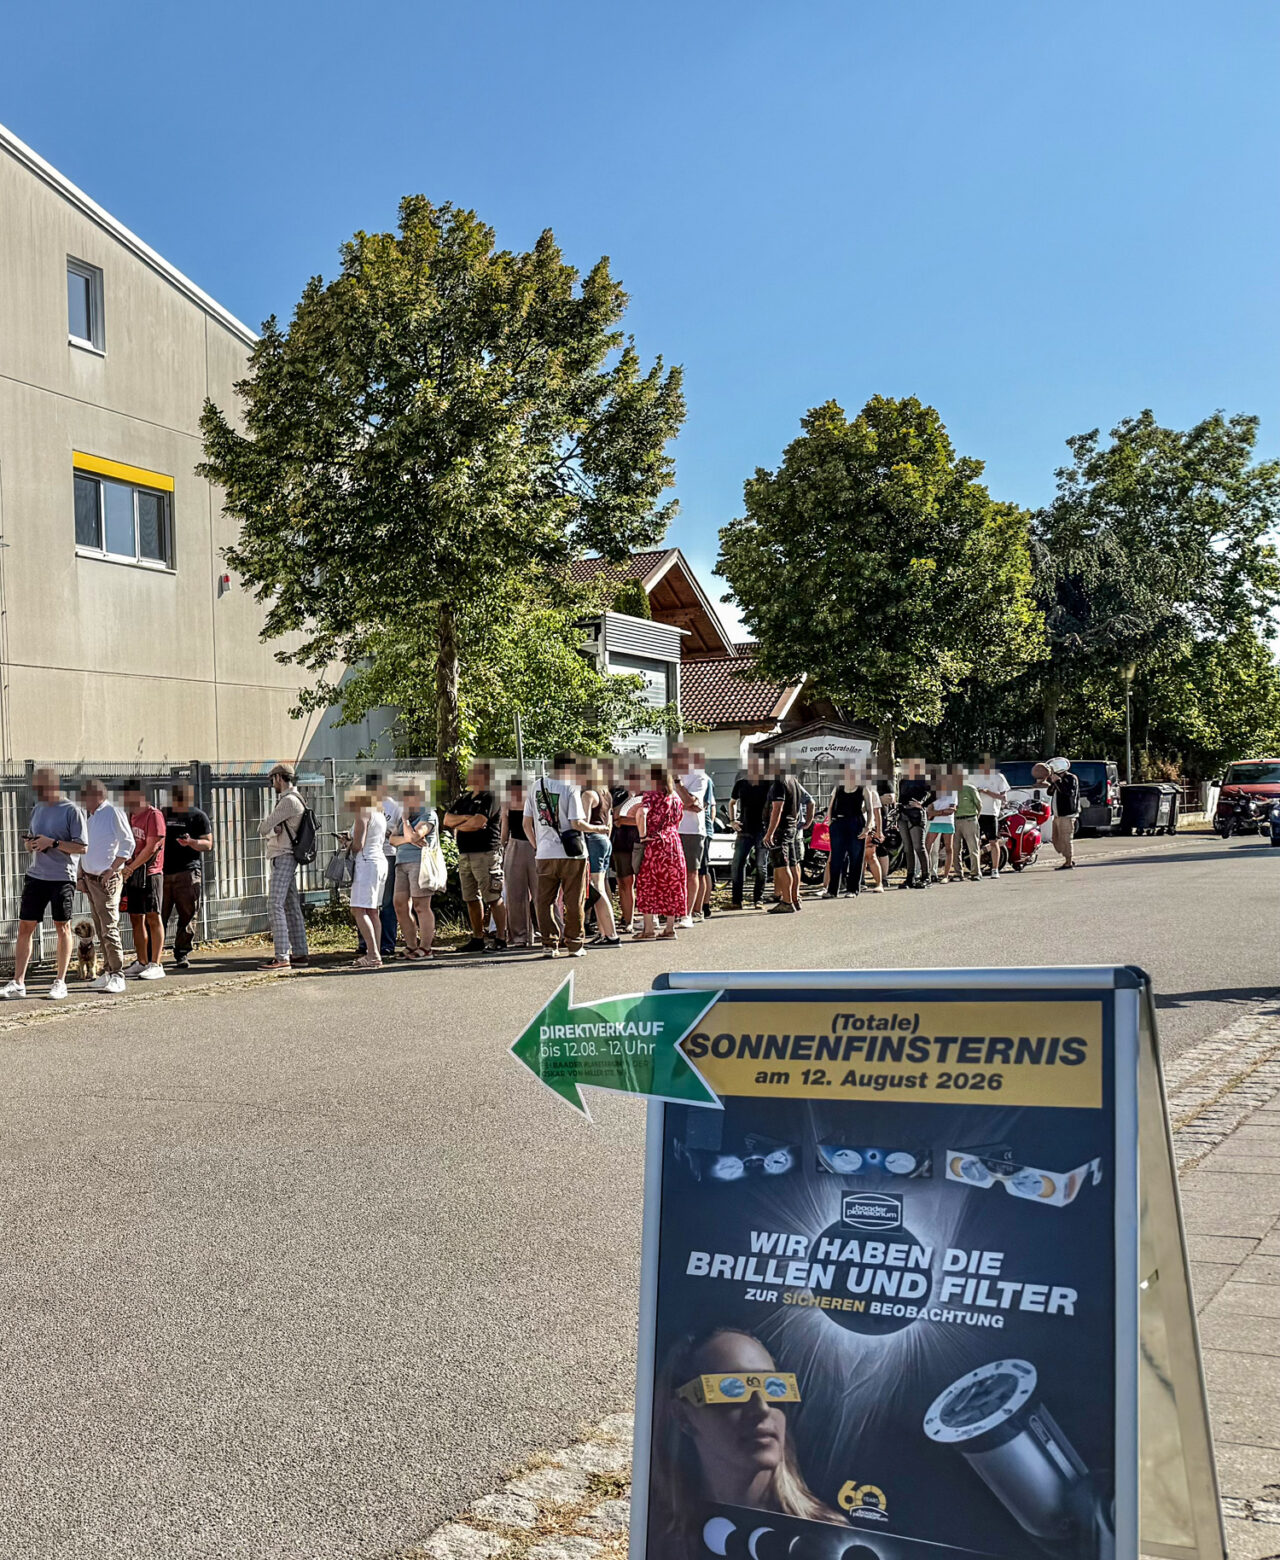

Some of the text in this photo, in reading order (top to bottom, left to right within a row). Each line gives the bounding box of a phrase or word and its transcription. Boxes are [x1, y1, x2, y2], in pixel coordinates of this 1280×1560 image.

[540, 1021, 665, 1039] DIREKTVERKAUF
[831, 1013, 920, 1034] (Totale)
[541, 1042, 560, 1057] bis
[563, 1041, 599, 1057] 12.08.
[625, 1039, 656, 1055] Uhr
[686, 1033, 1088, 1066] SONNENFINSTERNIS
[754, 1069, 1003, 1091] am 12. August 2026
[749, 1231, 1005, 1276] WIR HABEN DIE
[686, 1250, 1079, 1316] BRILLEN UND FILTER
[744, 1288, 1004, 1329] ZUR SICHEREN BEOBACHTUNG
[837, 1480, 887, 1511] 60
